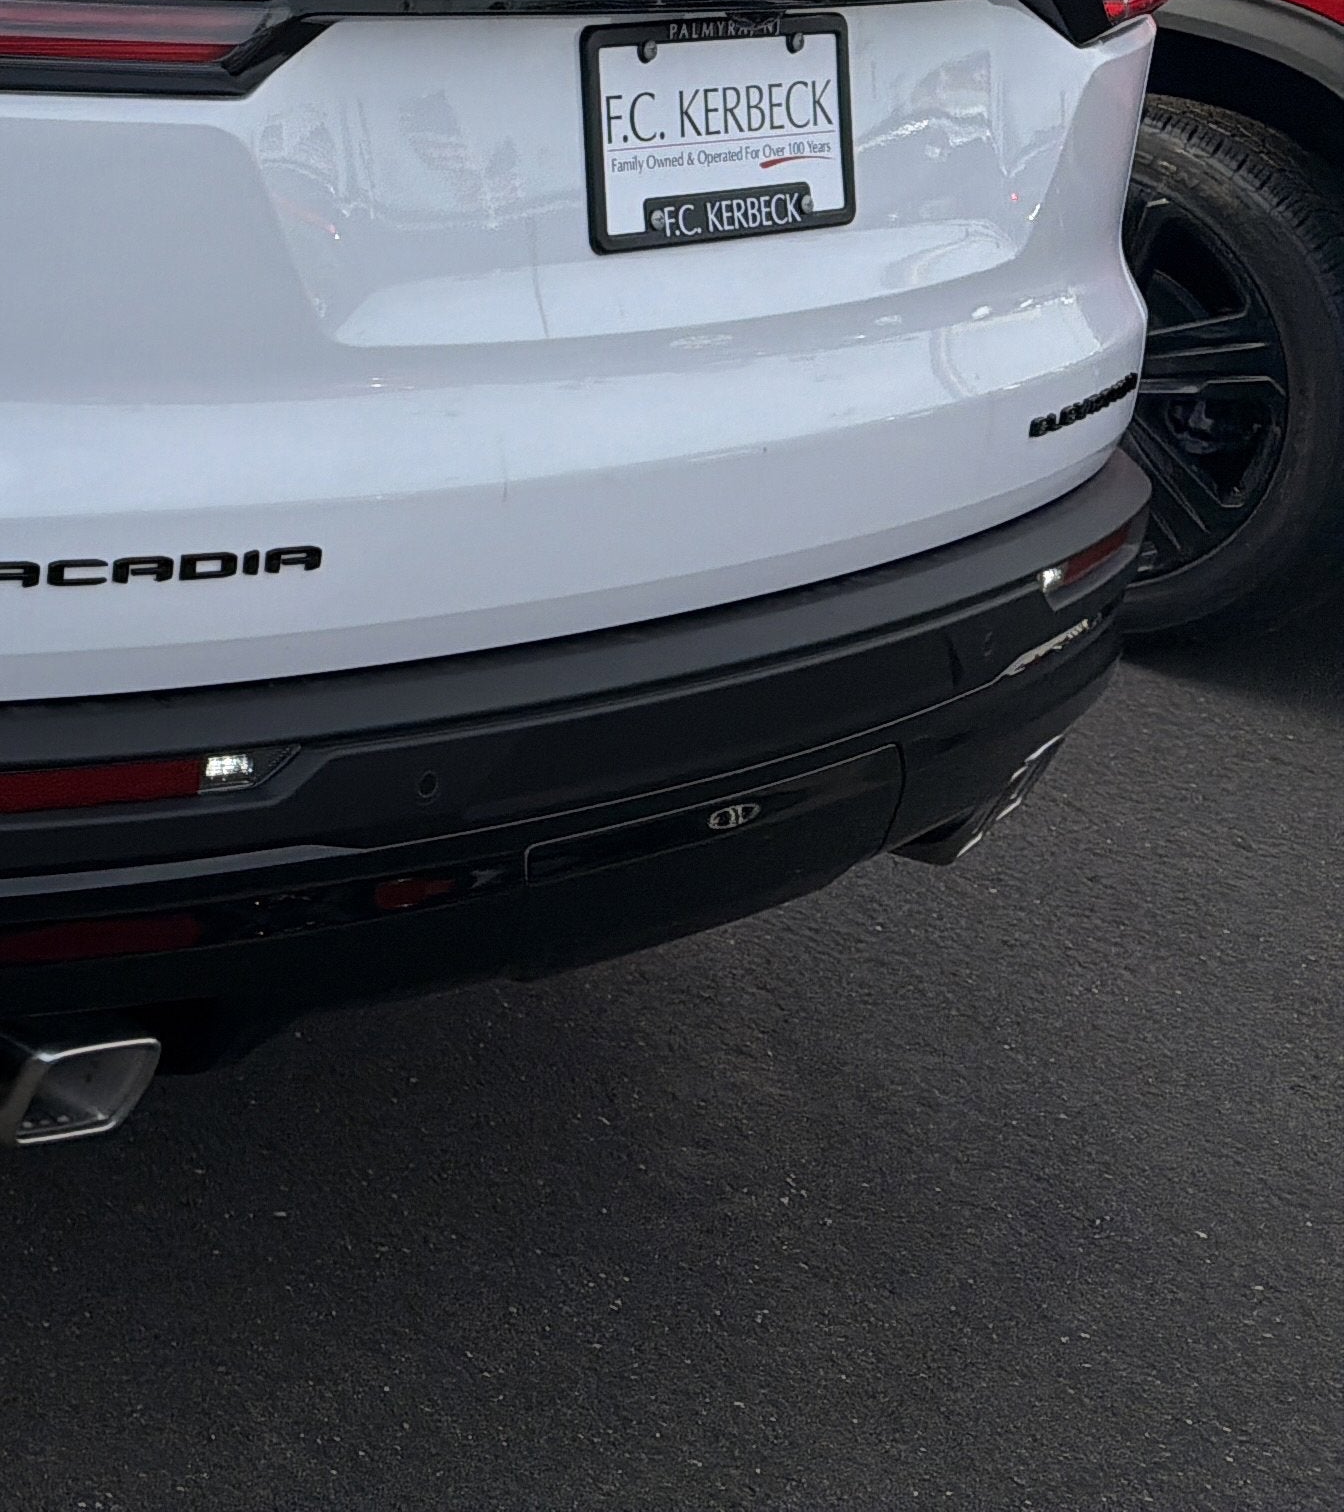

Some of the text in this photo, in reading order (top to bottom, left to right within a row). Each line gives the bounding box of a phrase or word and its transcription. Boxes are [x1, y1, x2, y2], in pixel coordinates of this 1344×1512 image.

[606, 79, 834, 145] F.C. KERBECK
[611, 140, 832, 175] Family Owned & Operated For Over 100 Years
[663, 193, 802, 238] F.C. KERBECK
